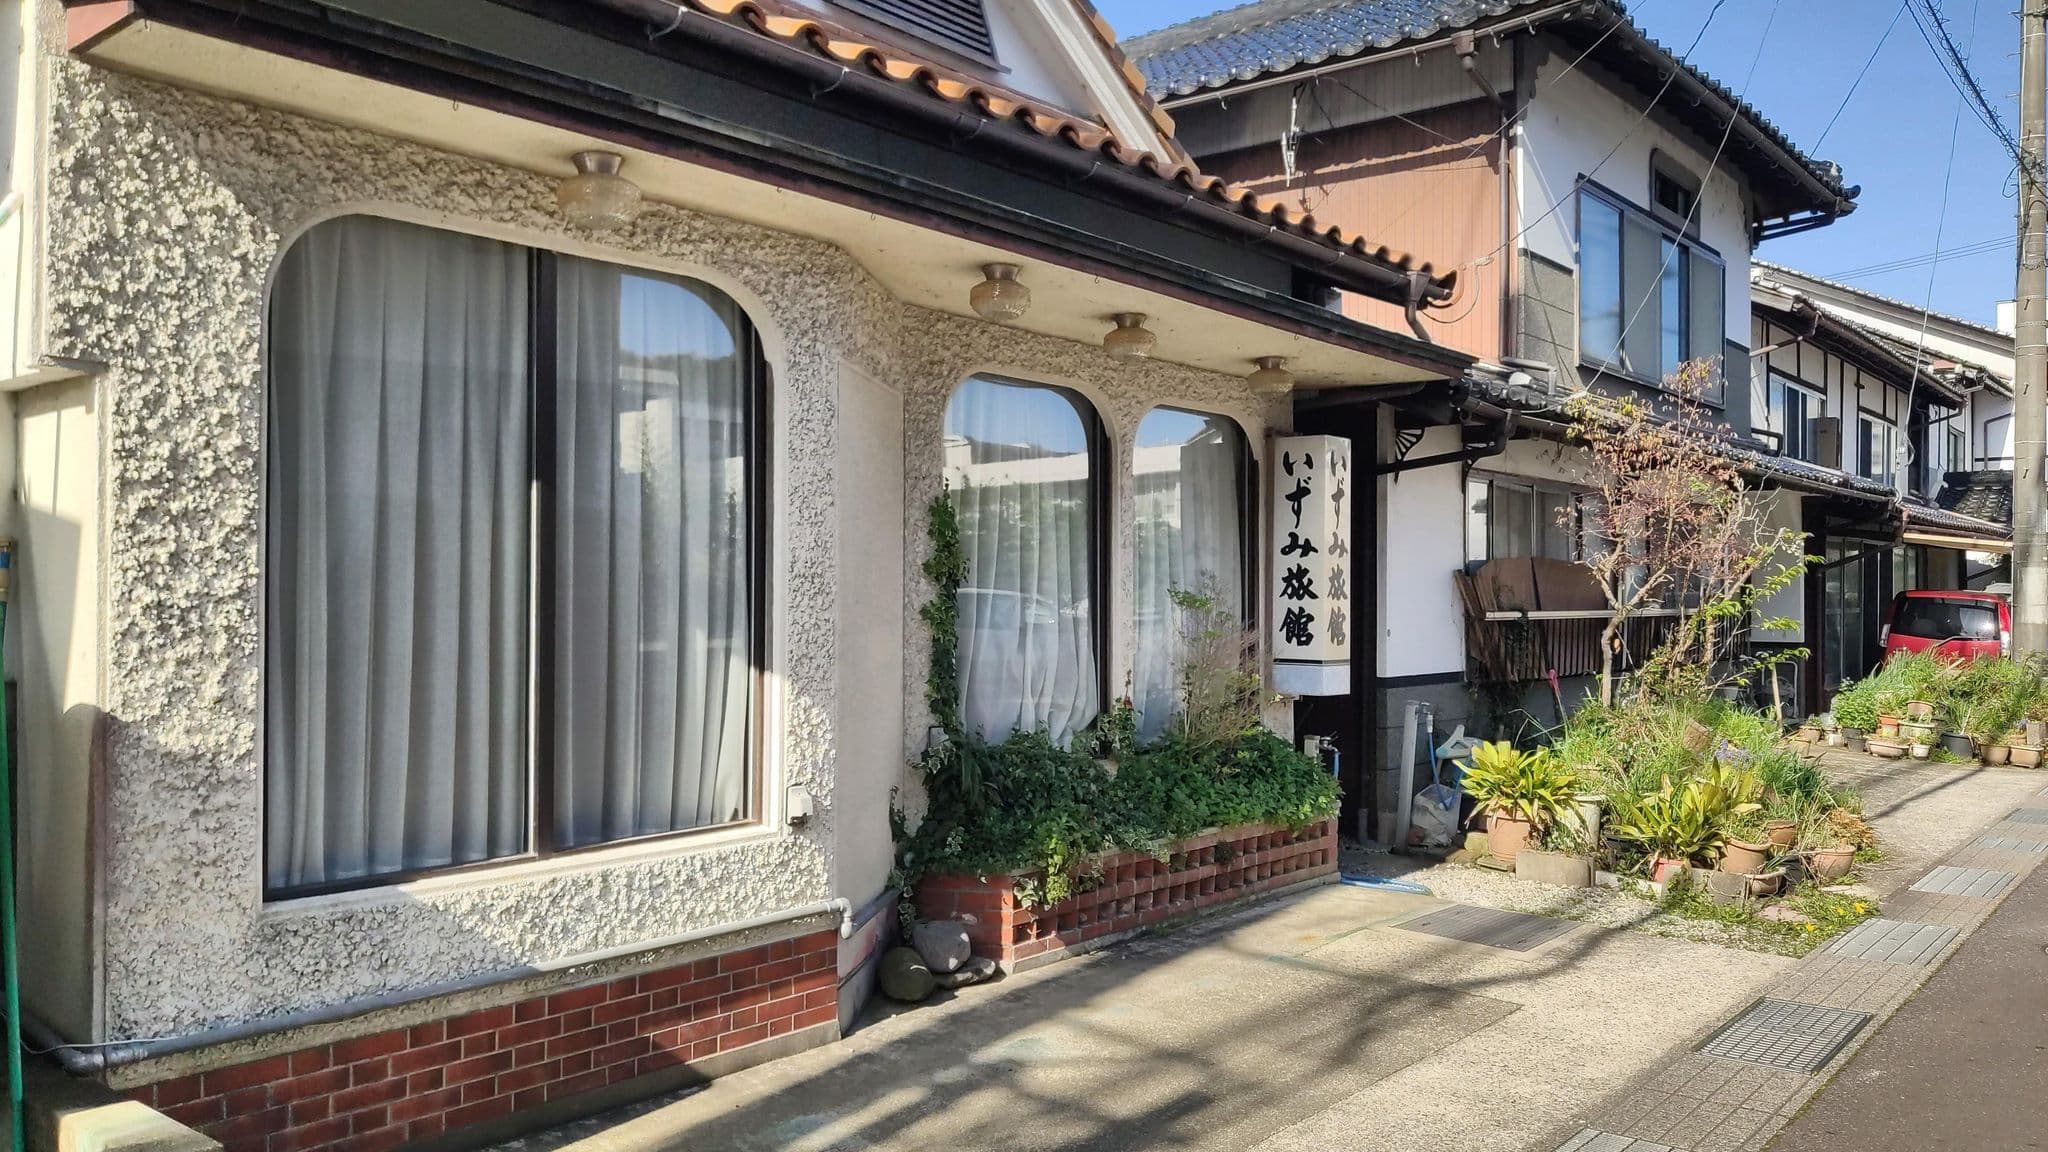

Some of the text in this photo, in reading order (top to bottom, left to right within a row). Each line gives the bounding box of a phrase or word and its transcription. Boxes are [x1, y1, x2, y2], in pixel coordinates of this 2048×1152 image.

[1279, 450, 1319, 647] いずみ旅館
[1327, 449, 1348, 647] いずみ旅館
